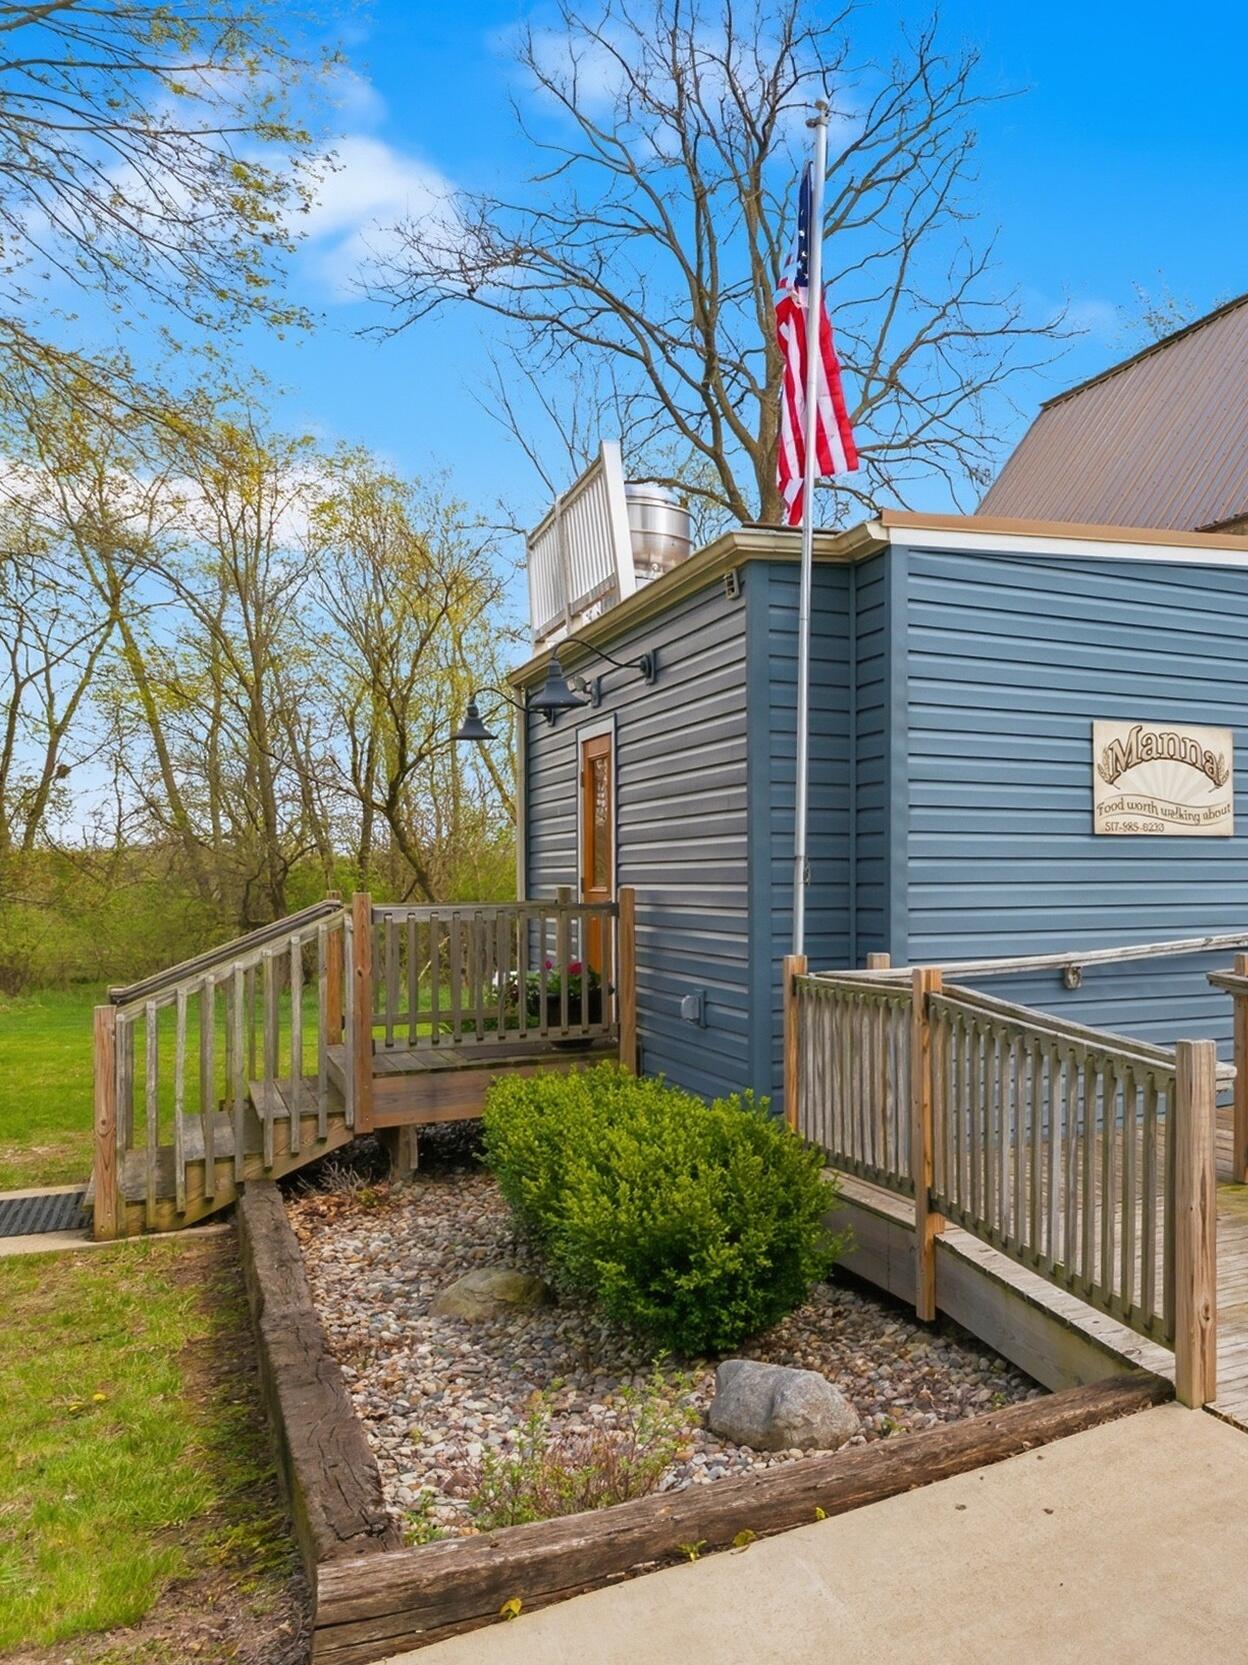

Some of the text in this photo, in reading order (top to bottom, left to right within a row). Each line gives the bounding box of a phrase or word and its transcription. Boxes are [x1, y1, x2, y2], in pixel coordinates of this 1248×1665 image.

[1109, 725, 1223, 787] Manna
[1097, 798, 1231, 824] Food worth walking about
